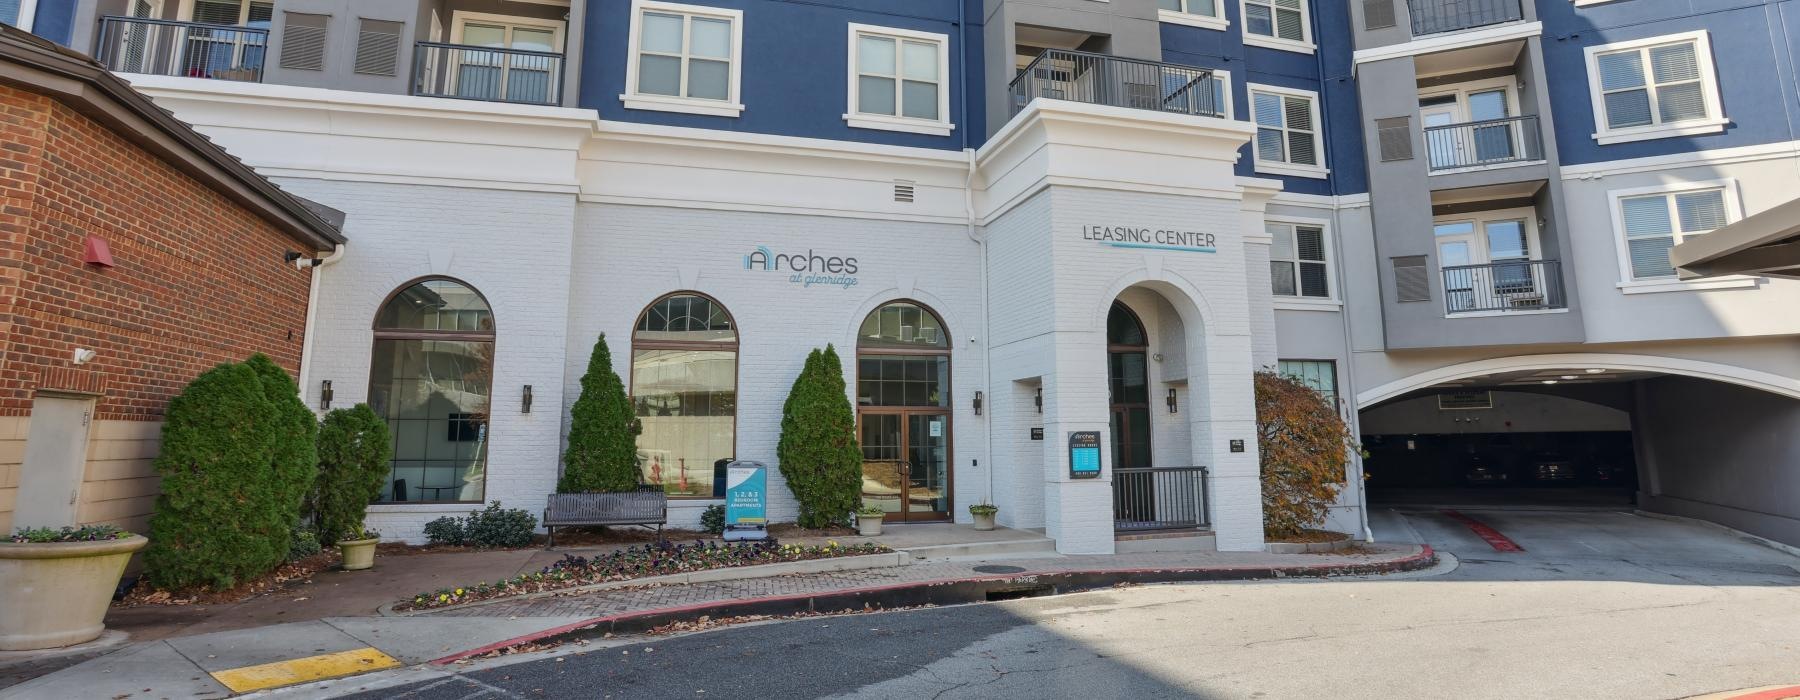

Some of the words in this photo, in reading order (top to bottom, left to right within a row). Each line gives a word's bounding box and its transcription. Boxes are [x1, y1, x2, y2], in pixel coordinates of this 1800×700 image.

[1083, 225, 1151, 243] LEASING
[1155, 230, 1216, 247] CENTER
[744, 246, 858, 274] Arches
[789, 273, 802, 283] at
[804, 272, 858, 289] glenridge
